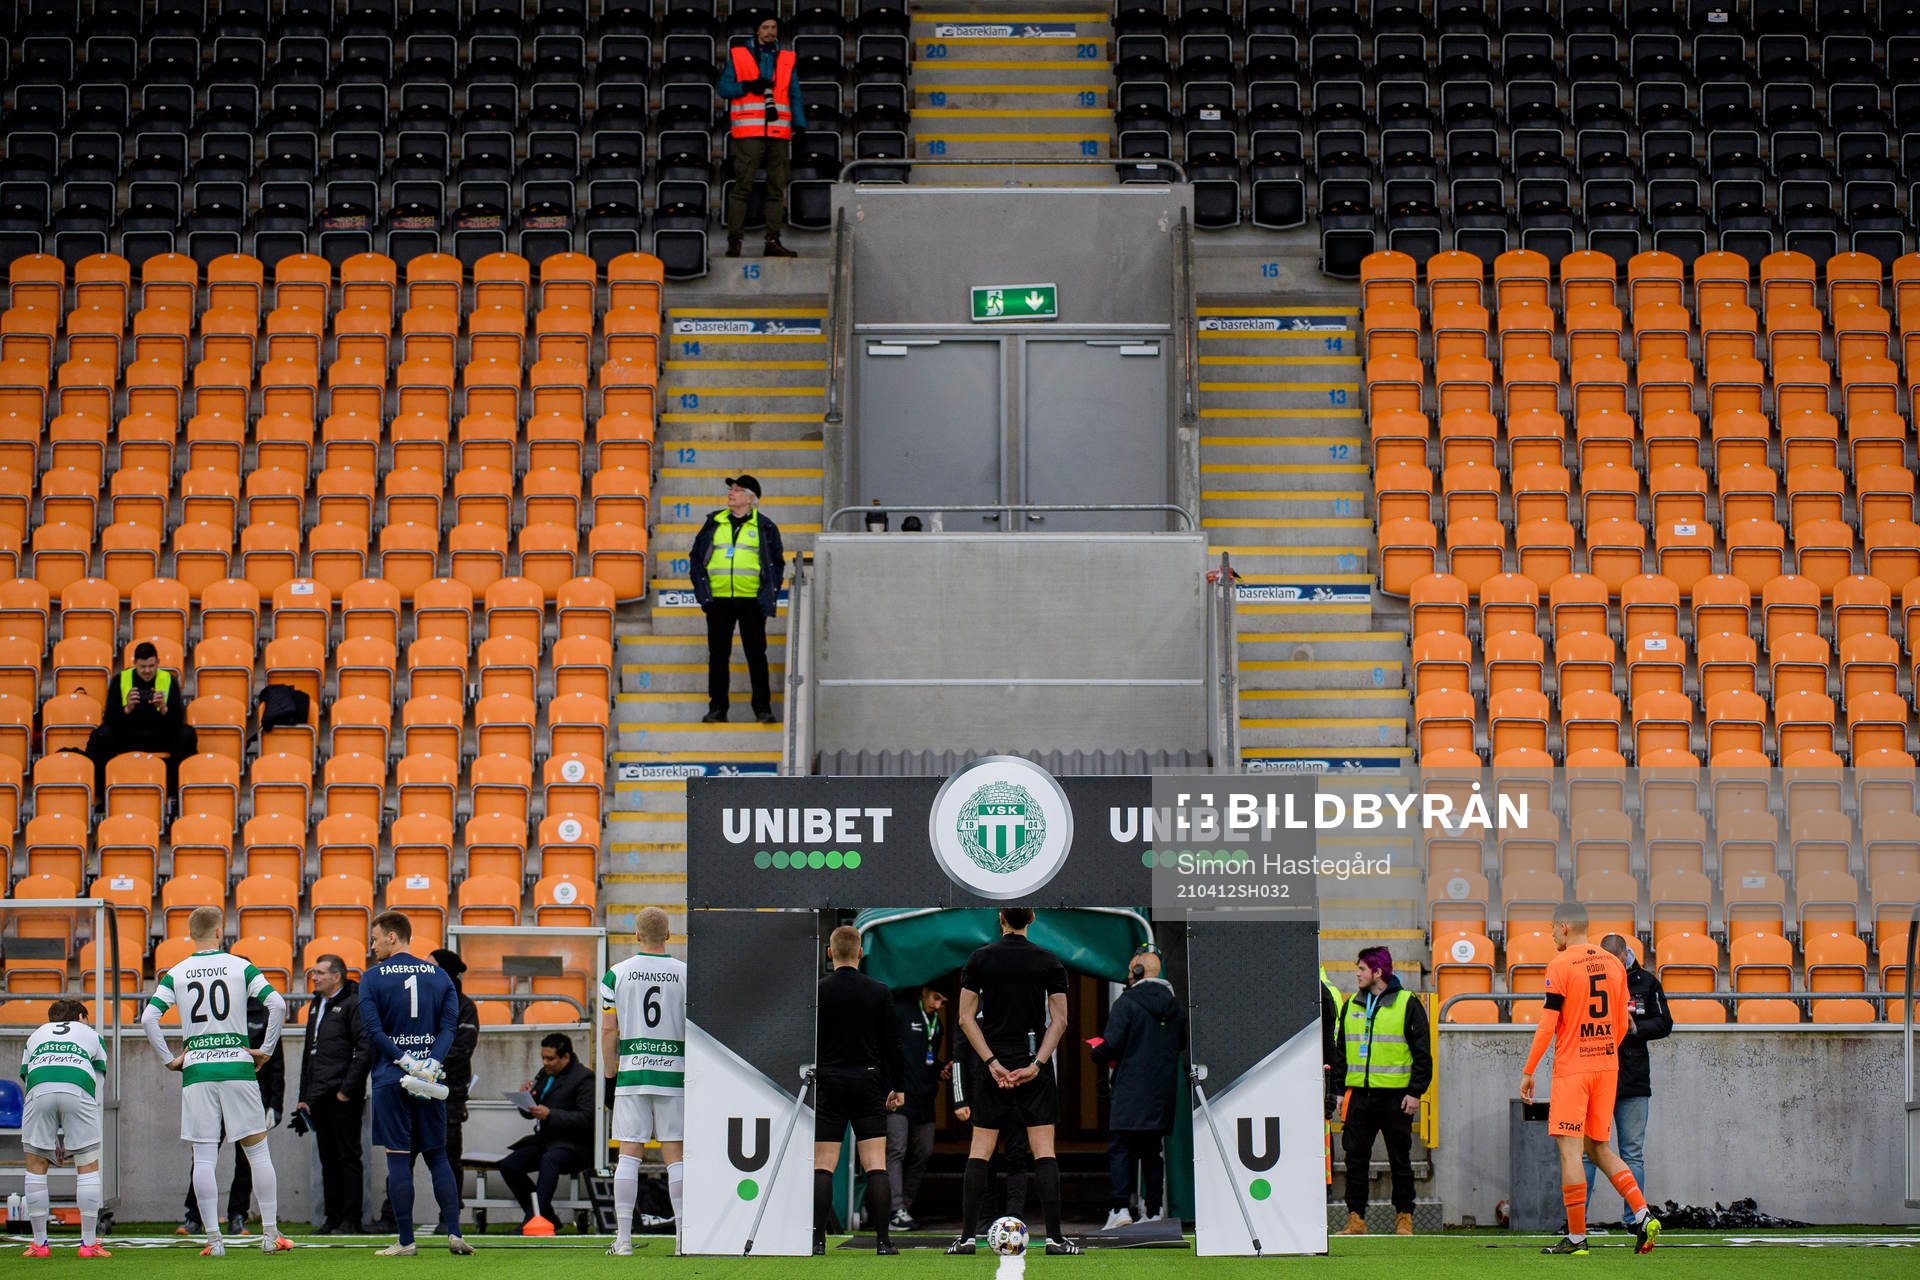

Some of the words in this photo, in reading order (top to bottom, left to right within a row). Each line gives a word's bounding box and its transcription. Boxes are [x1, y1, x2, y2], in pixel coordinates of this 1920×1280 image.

[956, 24, 1008, 37] basreklam
[926, 44, 947, 58] 20
[1077, 43, 1097, 58] 20
[928, 91, 946, 106] 19
[1078, 91, 1096, 106] 19
[1080, 140, 1098, 155] 18
[742, 265, 761, 279] 15
[1261, 264, 1279, 278] 15
[694, 320, 749, 333] basreklam
[1221, 318, 1275, 330] basreklam
[682, 341, 701, 356] 14
[1325, 337, 1343, 351] 14
[680, 394, 699, 408] 13
[1329, 390, 1346, 405] 13
[677, 449, 696, 463] 12
[1329, 445, 1348, 459] 12
[673, 503, 690, 518] 11
[1332, 497, 1350, 514] 11
[670, 559, 688, 574] 10
[1238, 585, 1296, 600] basreklam
[642, 764, 700, 779] basreklam
[1265, 760, 1324, 773] basreklam
[986, 806, 1018, 814] VSK
[722, 807, 893, 843] UNIBET
[965, 821, 974, 829] 19
[1028, 821, 1038, 829] 04
[1110, 806, 1280, 842] UNIBET
[186, 967, 228, 979] CUSTOVIC
[628, 971, 680, 983] JOHANSSON
[187, 979, 230, 1023] 20
[404, 974, 418, 1018] 1
[1588, 974, 1609, 1018] 5
[643, 985, 662, 1028] 6
[52, 1022, 71, 1035] 3
[1580, 1023, 1612, 1037] MAX
[727, 1117, 771, 1172] U
[1237, 1116, 1280, 1172] U
